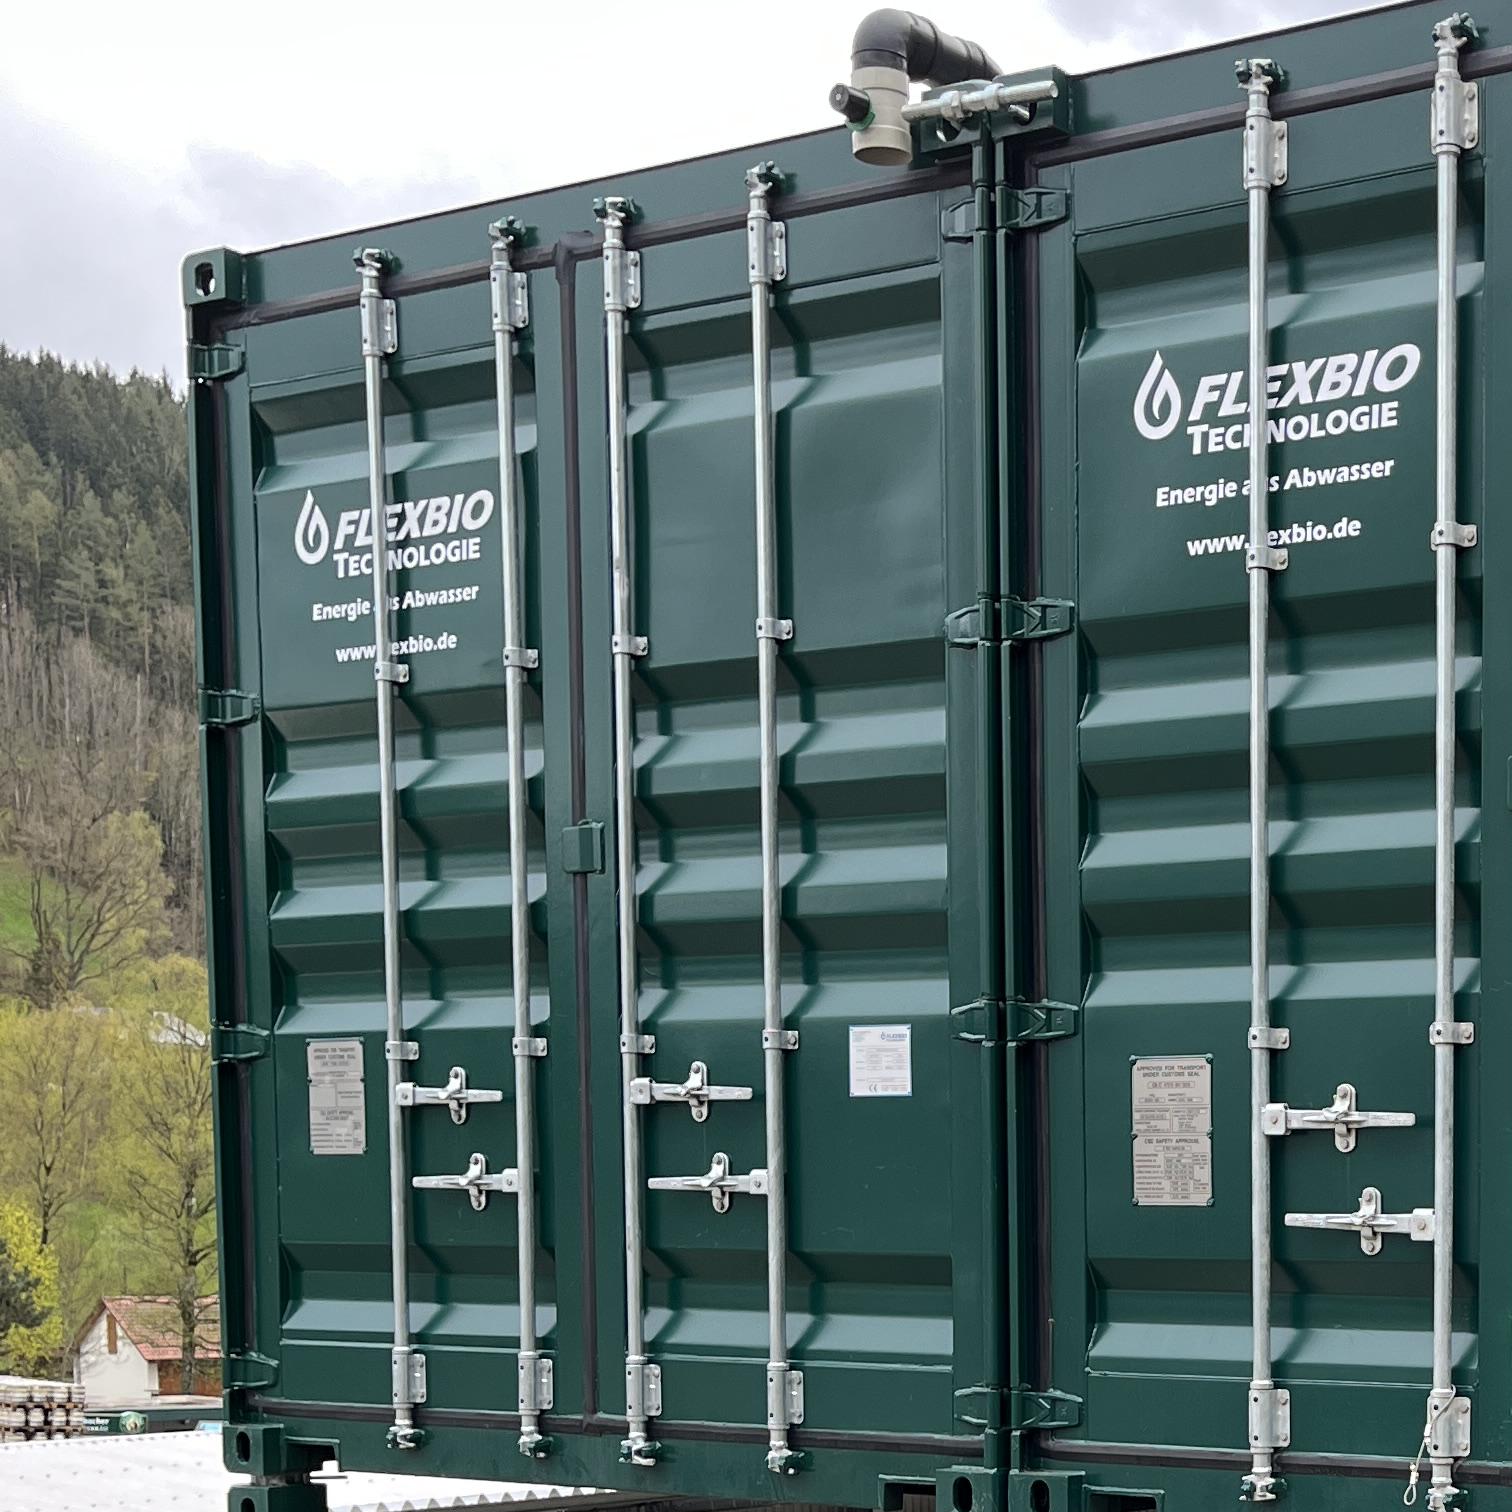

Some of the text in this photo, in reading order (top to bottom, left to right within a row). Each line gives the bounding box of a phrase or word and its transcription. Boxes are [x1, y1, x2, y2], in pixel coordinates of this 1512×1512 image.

[1188, 343, 1421, 422] FLEXBIO
[1156, 459, 1394, 508] Energie as Abwasser
[334, 490, 494, 550] FLEXBIO
[1186, 517, 1361, 556] www.exbio.de
[333, 537, 480, 578] TECNOLOGIE
[312, 598, 370, 622] Energie
[402, 586, 479, 609] Abwasser
[336, 632, 457, 663] wwwexbio.de
